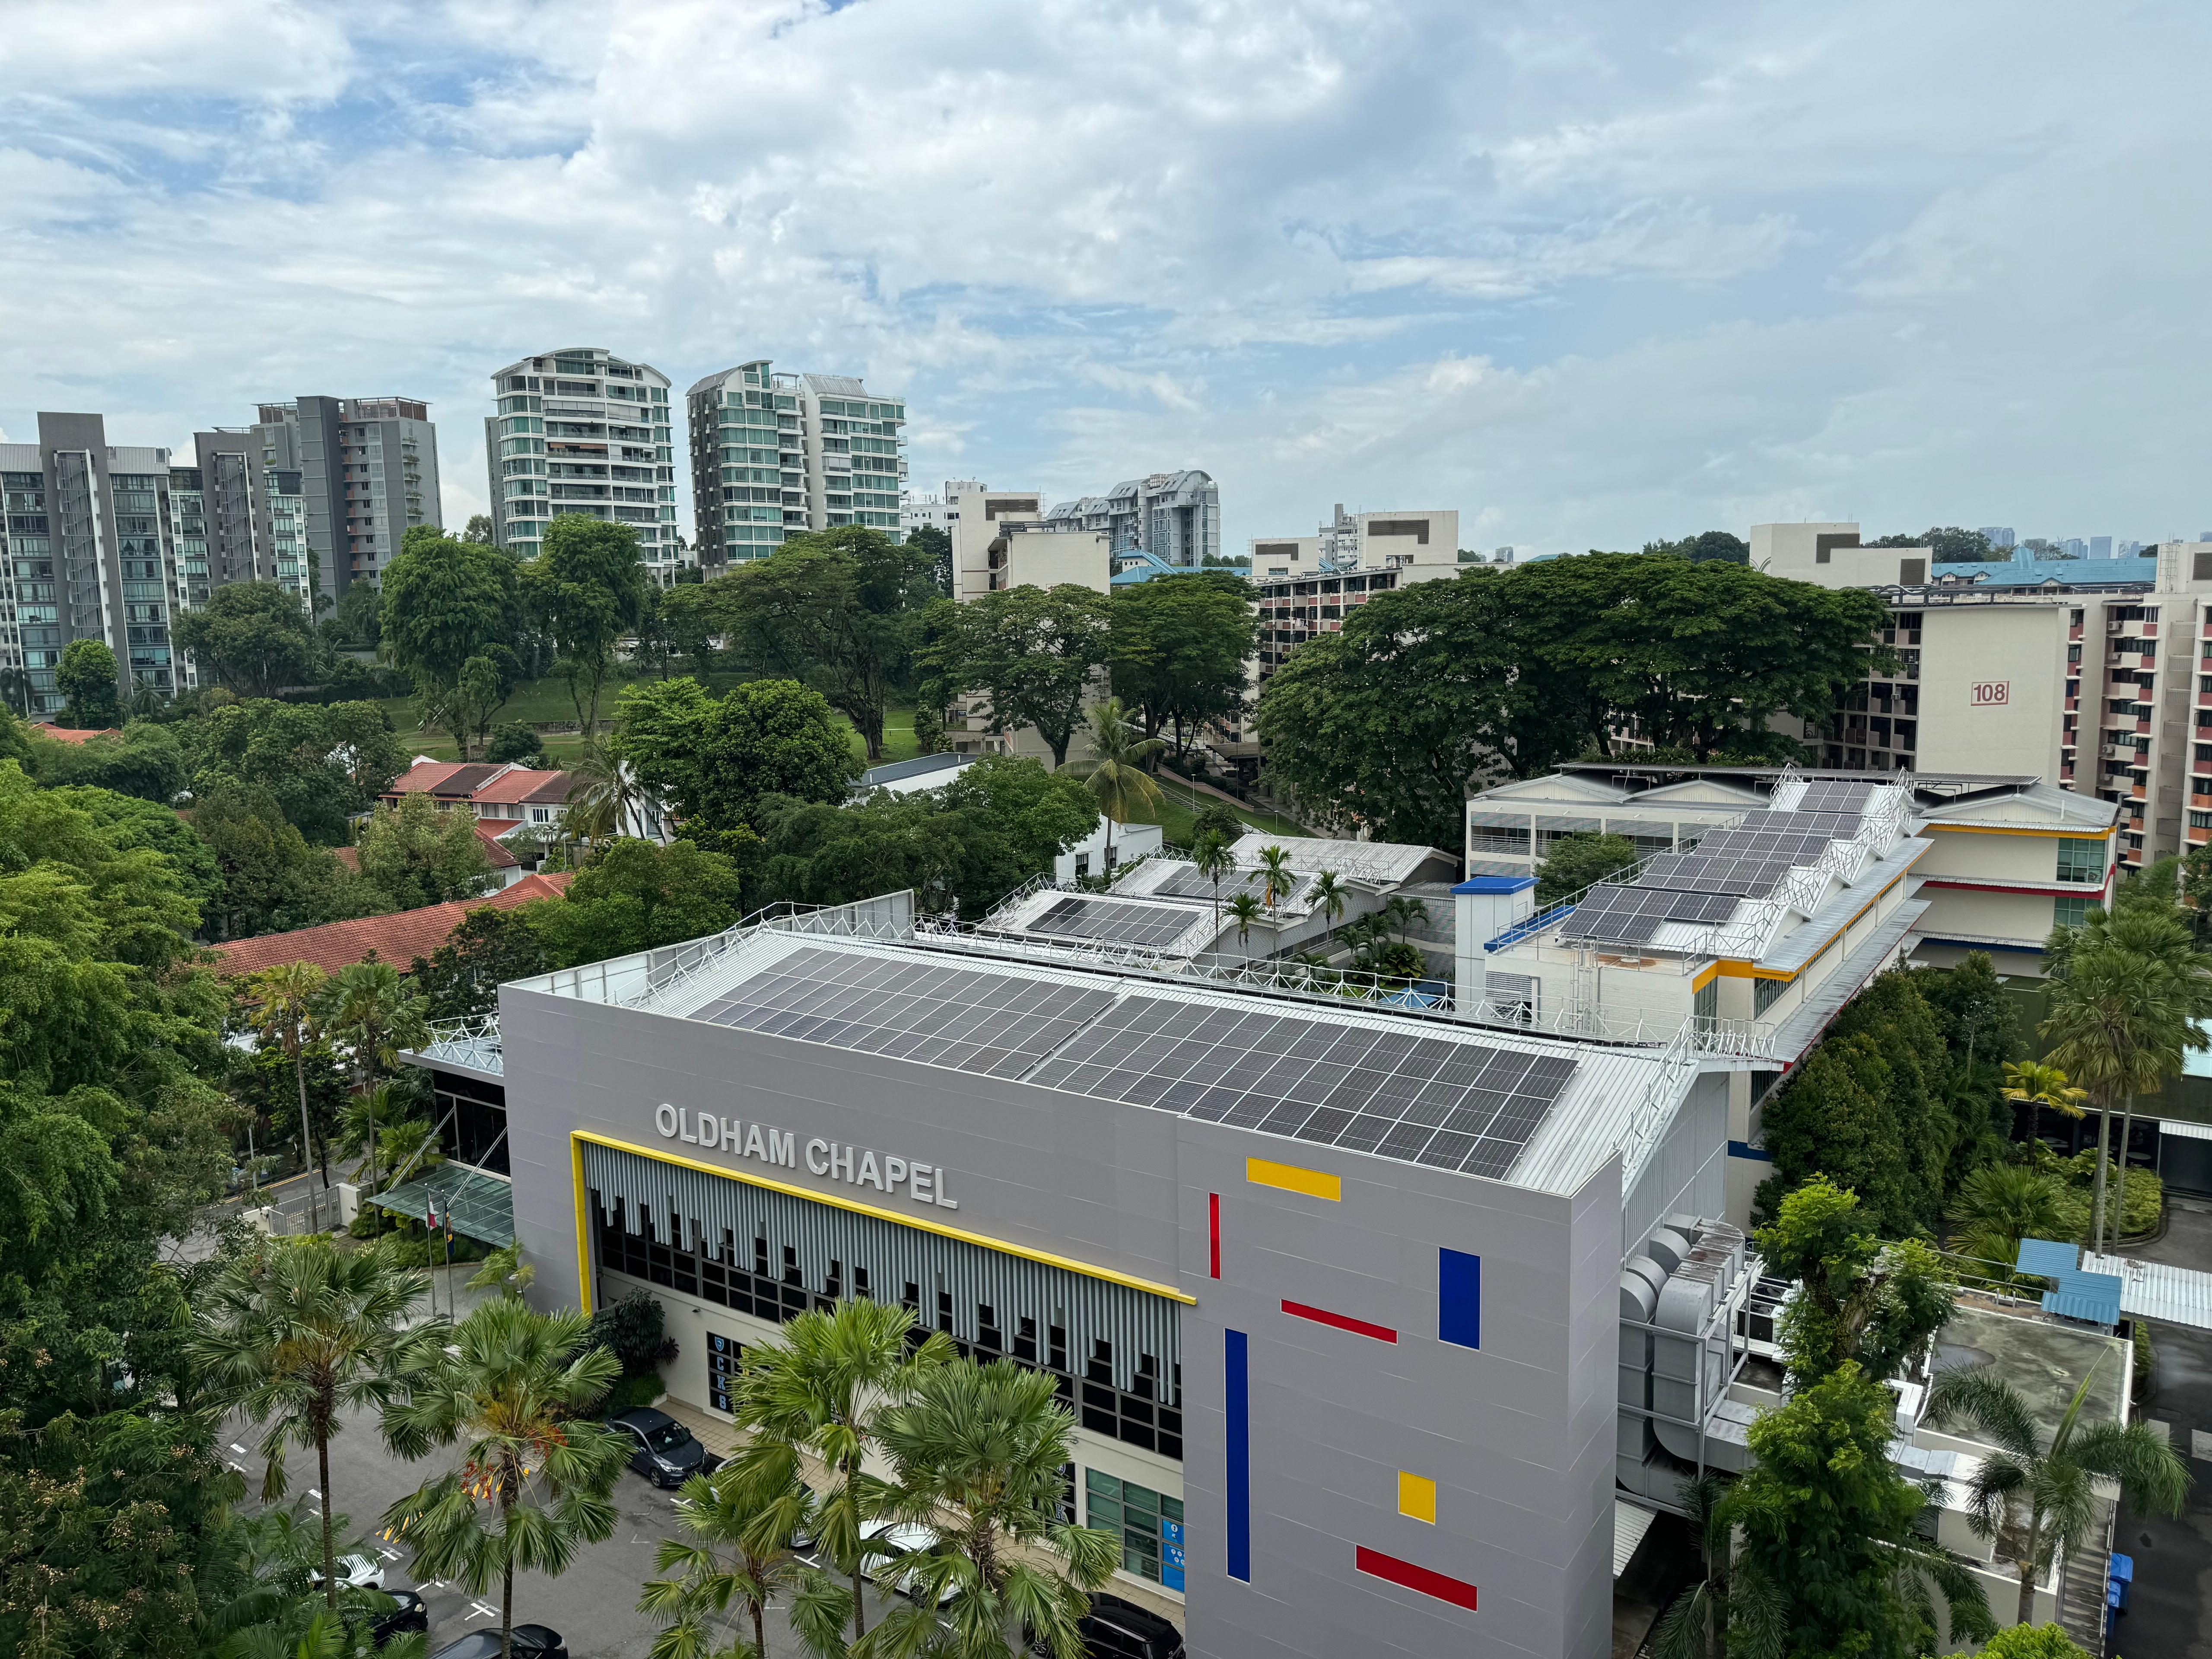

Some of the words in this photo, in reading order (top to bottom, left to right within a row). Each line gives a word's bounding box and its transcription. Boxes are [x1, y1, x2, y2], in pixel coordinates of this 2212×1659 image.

[1974, 683, 2005, 702] 108
[655, 1103, 795, 1168] OLDHAM
[806, 1138, 958, 1209] CHAPEL
